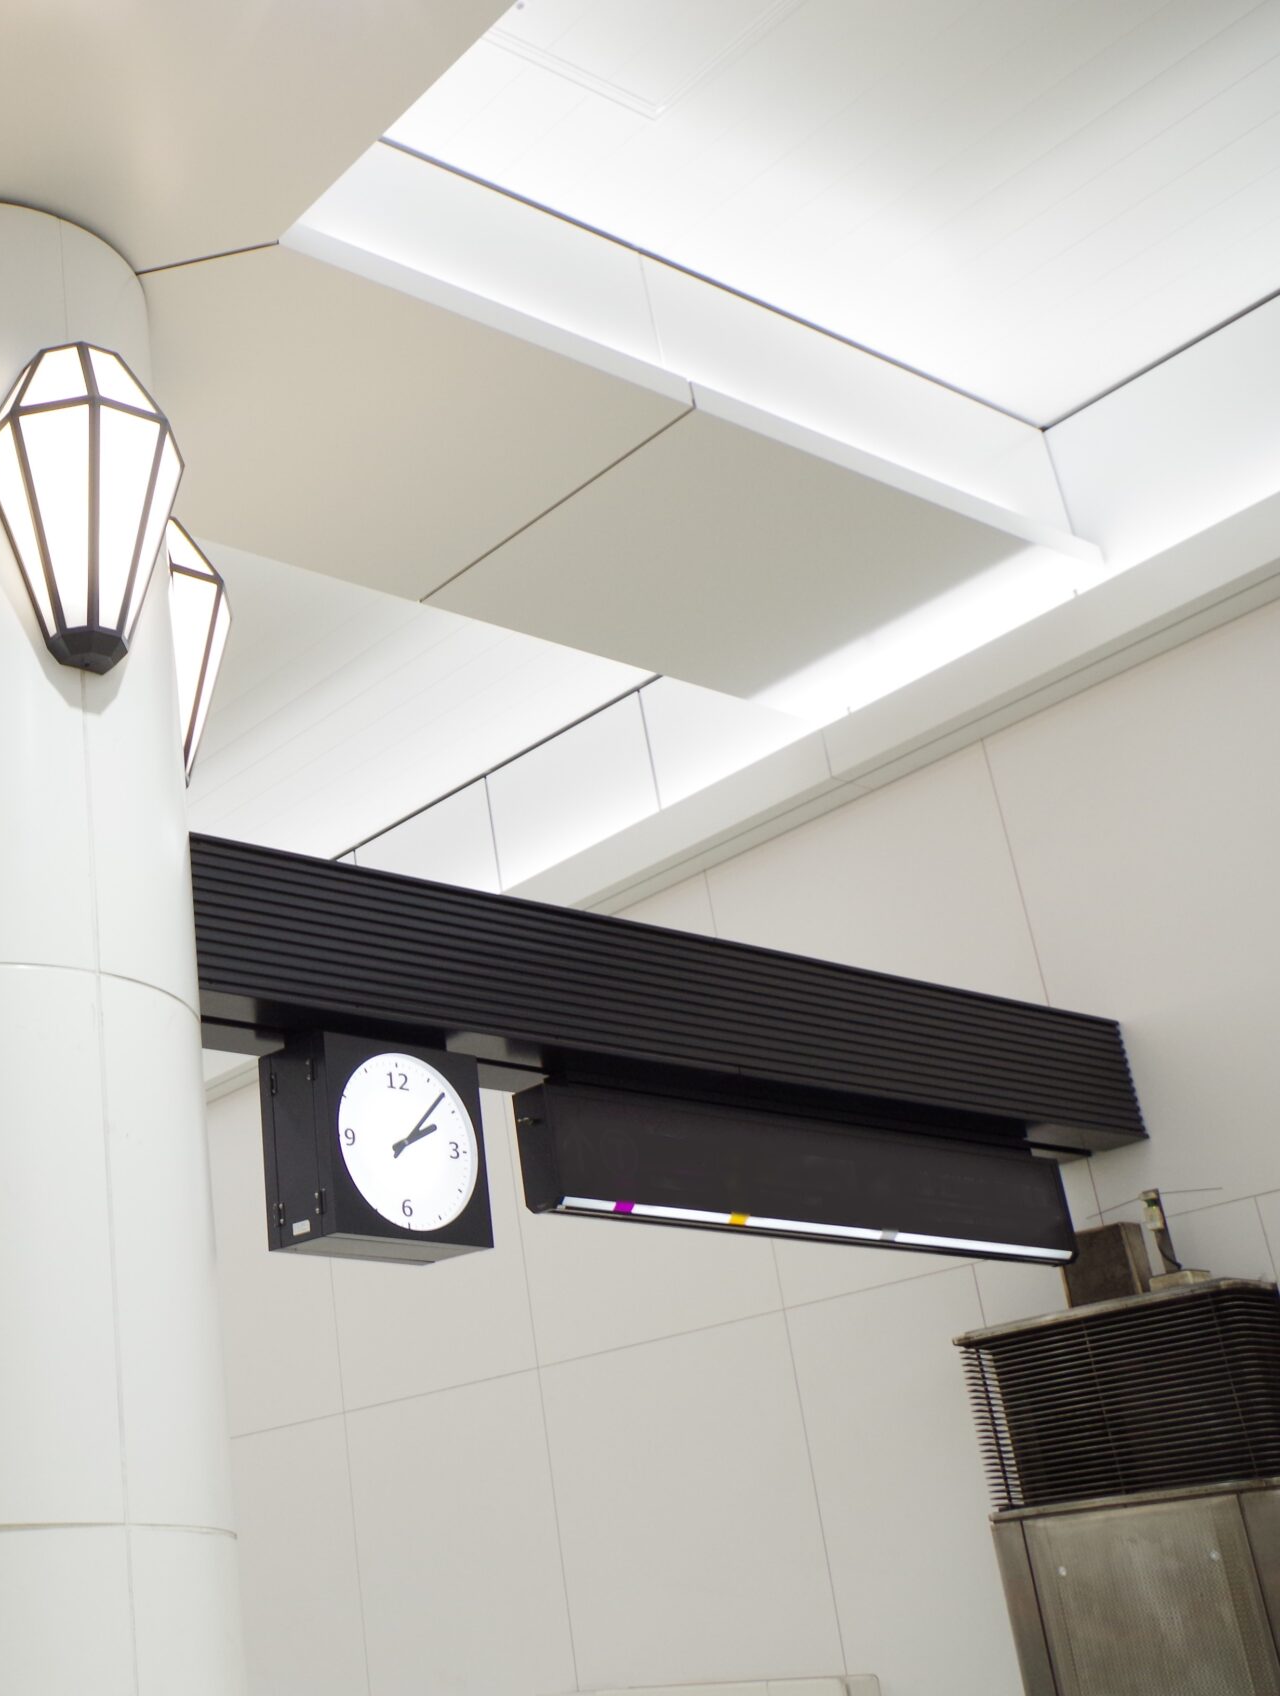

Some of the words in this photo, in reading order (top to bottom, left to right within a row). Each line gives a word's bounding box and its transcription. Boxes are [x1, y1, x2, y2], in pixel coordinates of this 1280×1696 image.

[386, 1072, 410, 1091] 12
[344, 1128, 356, 1146] 9
[448, 1141, 461, 1160] 3
[401, 1199, 414, 1217] 6
